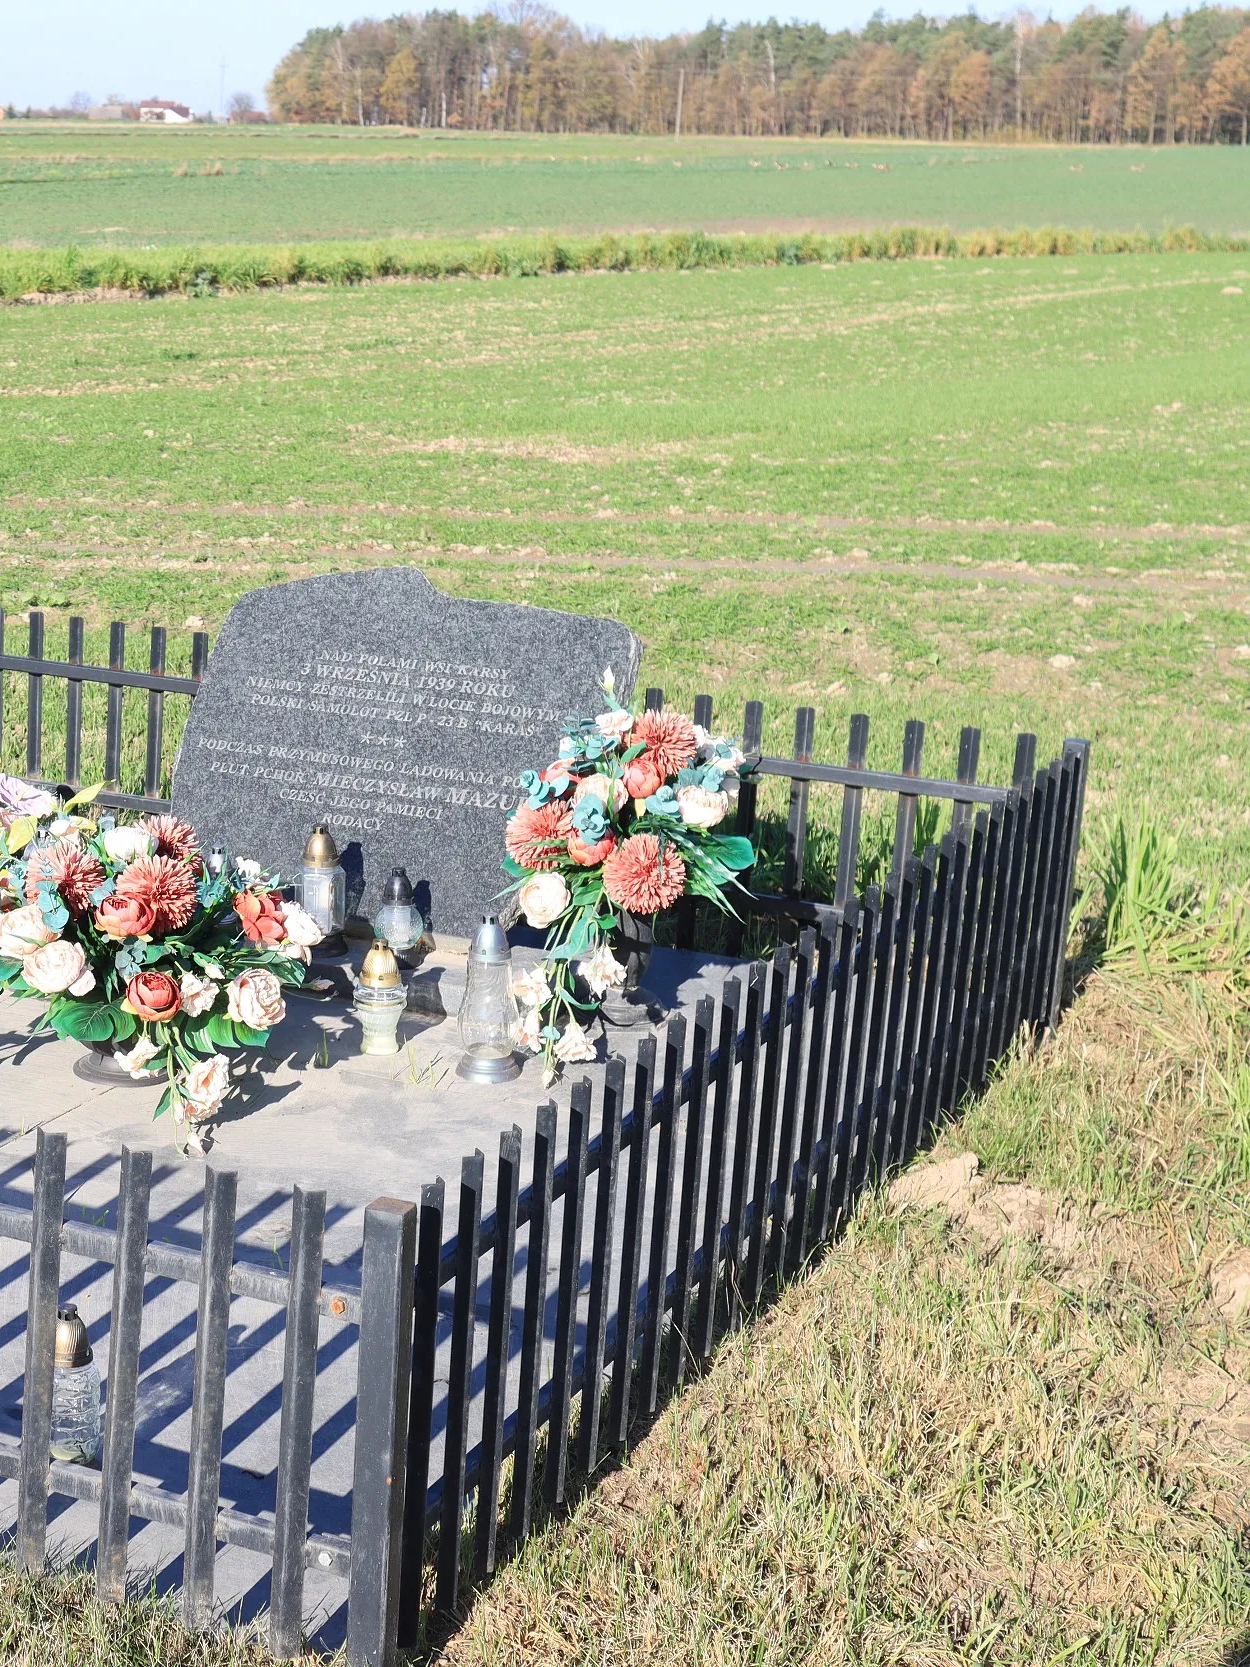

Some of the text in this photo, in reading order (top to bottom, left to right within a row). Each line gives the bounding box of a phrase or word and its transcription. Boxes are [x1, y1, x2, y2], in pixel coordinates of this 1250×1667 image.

[301, 663, 516, 698] 3 WRZEŚNIA 1939 ROKU
[316, 650, 511, 680] NAD POLAMI WSI KARSY
[246, 675, 560, 722] NIEMCY ZESTRZELILI W LOCIE BOJOWYM
[250, 693, 305, 709] POLSKI
[309, 699, 380, 718] SAMOLOT
[385, 709, 413, 722] PZL
[416, 713, 427, 724] P
[437, 715, 454, 727] 23
[456, 717, 468, 729] B
[198, 738, 264, 756] PODCZAS
[268, 746, 395, 772] PRZYMUSOWEGO
[313, 772, 443, 801] MIECZYSŁAW
[321, 812, 386, 831] RODACY
[330, 794, 371, 810] JEGO
[375, 800, 444, 820] PAMIĘCI
